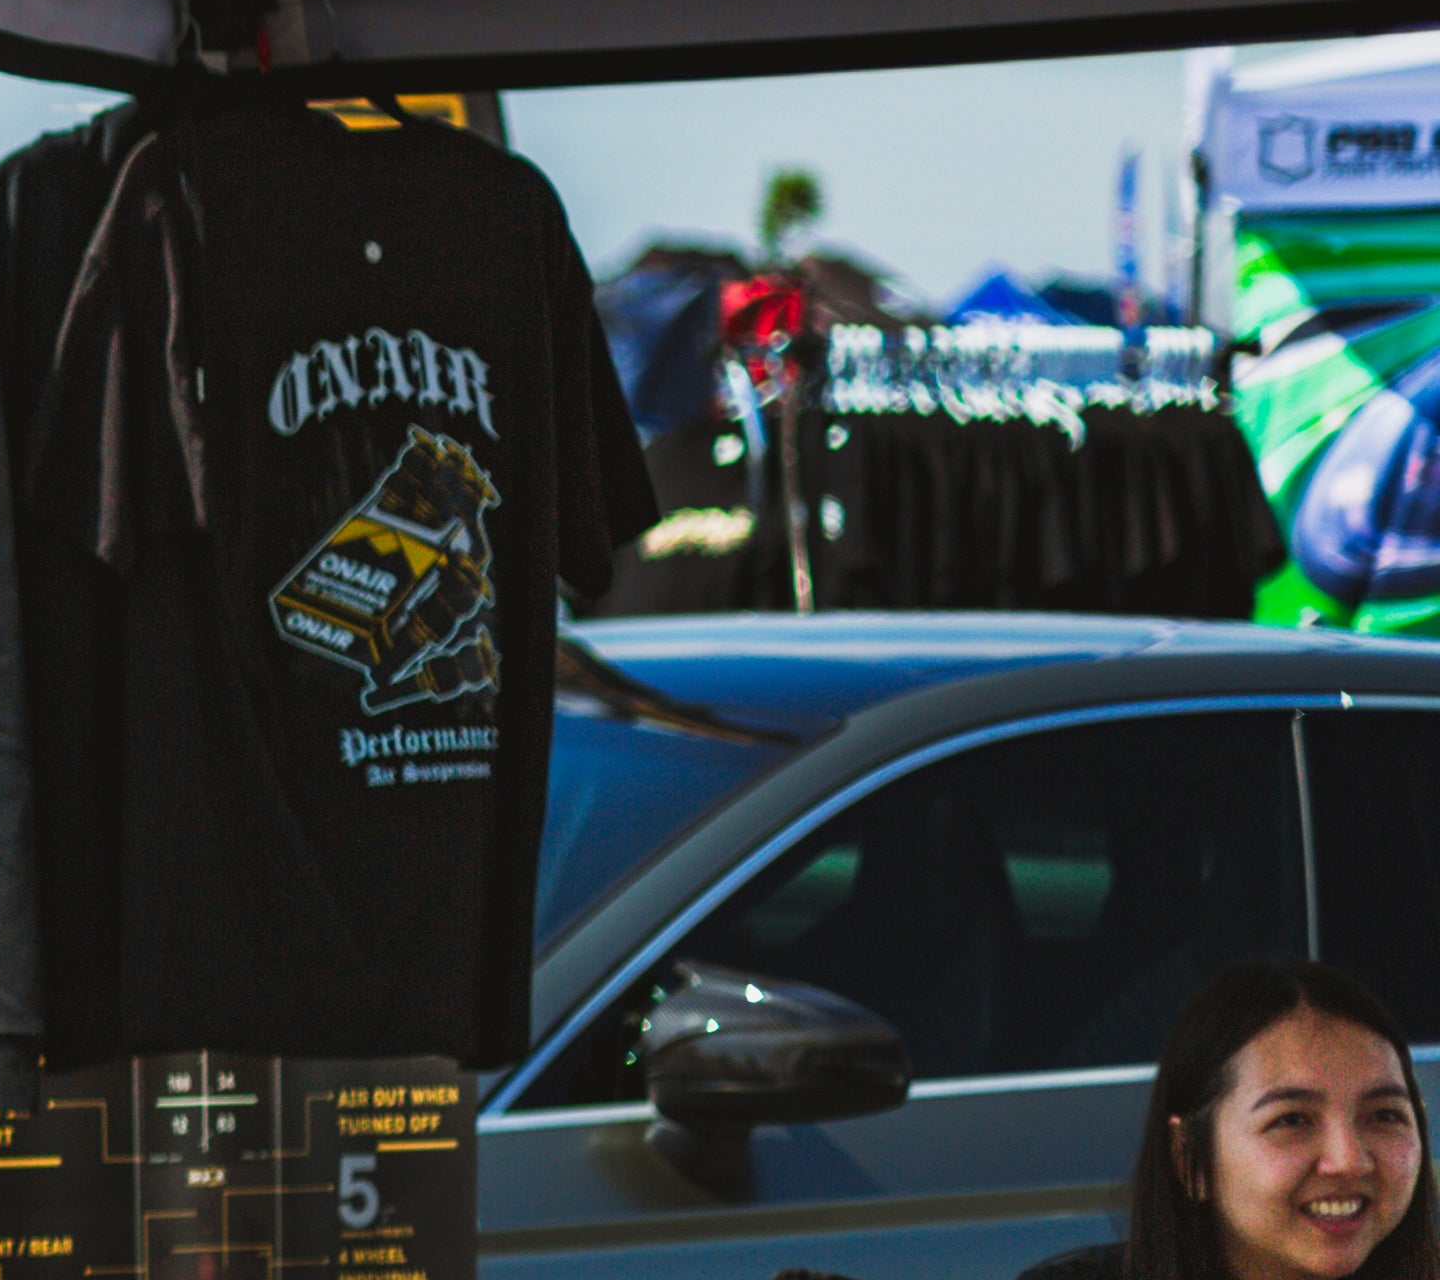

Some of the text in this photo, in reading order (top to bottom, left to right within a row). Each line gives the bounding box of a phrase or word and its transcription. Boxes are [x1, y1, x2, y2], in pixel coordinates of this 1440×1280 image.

[268, 326, 501, 441] ONAIR
[286, 611, 355, 652] ONAIR
[372, 1087, 406, 1106] OUT
[409, 1085, 459, 1106] WHEN
[337, 1113, 442, 1136] TURNED OFF
[338, 1152, 380, 1229] 5
[29, 1235, 73, 1257] REAR
[352, 1245, 408, 1265] WHEEL
